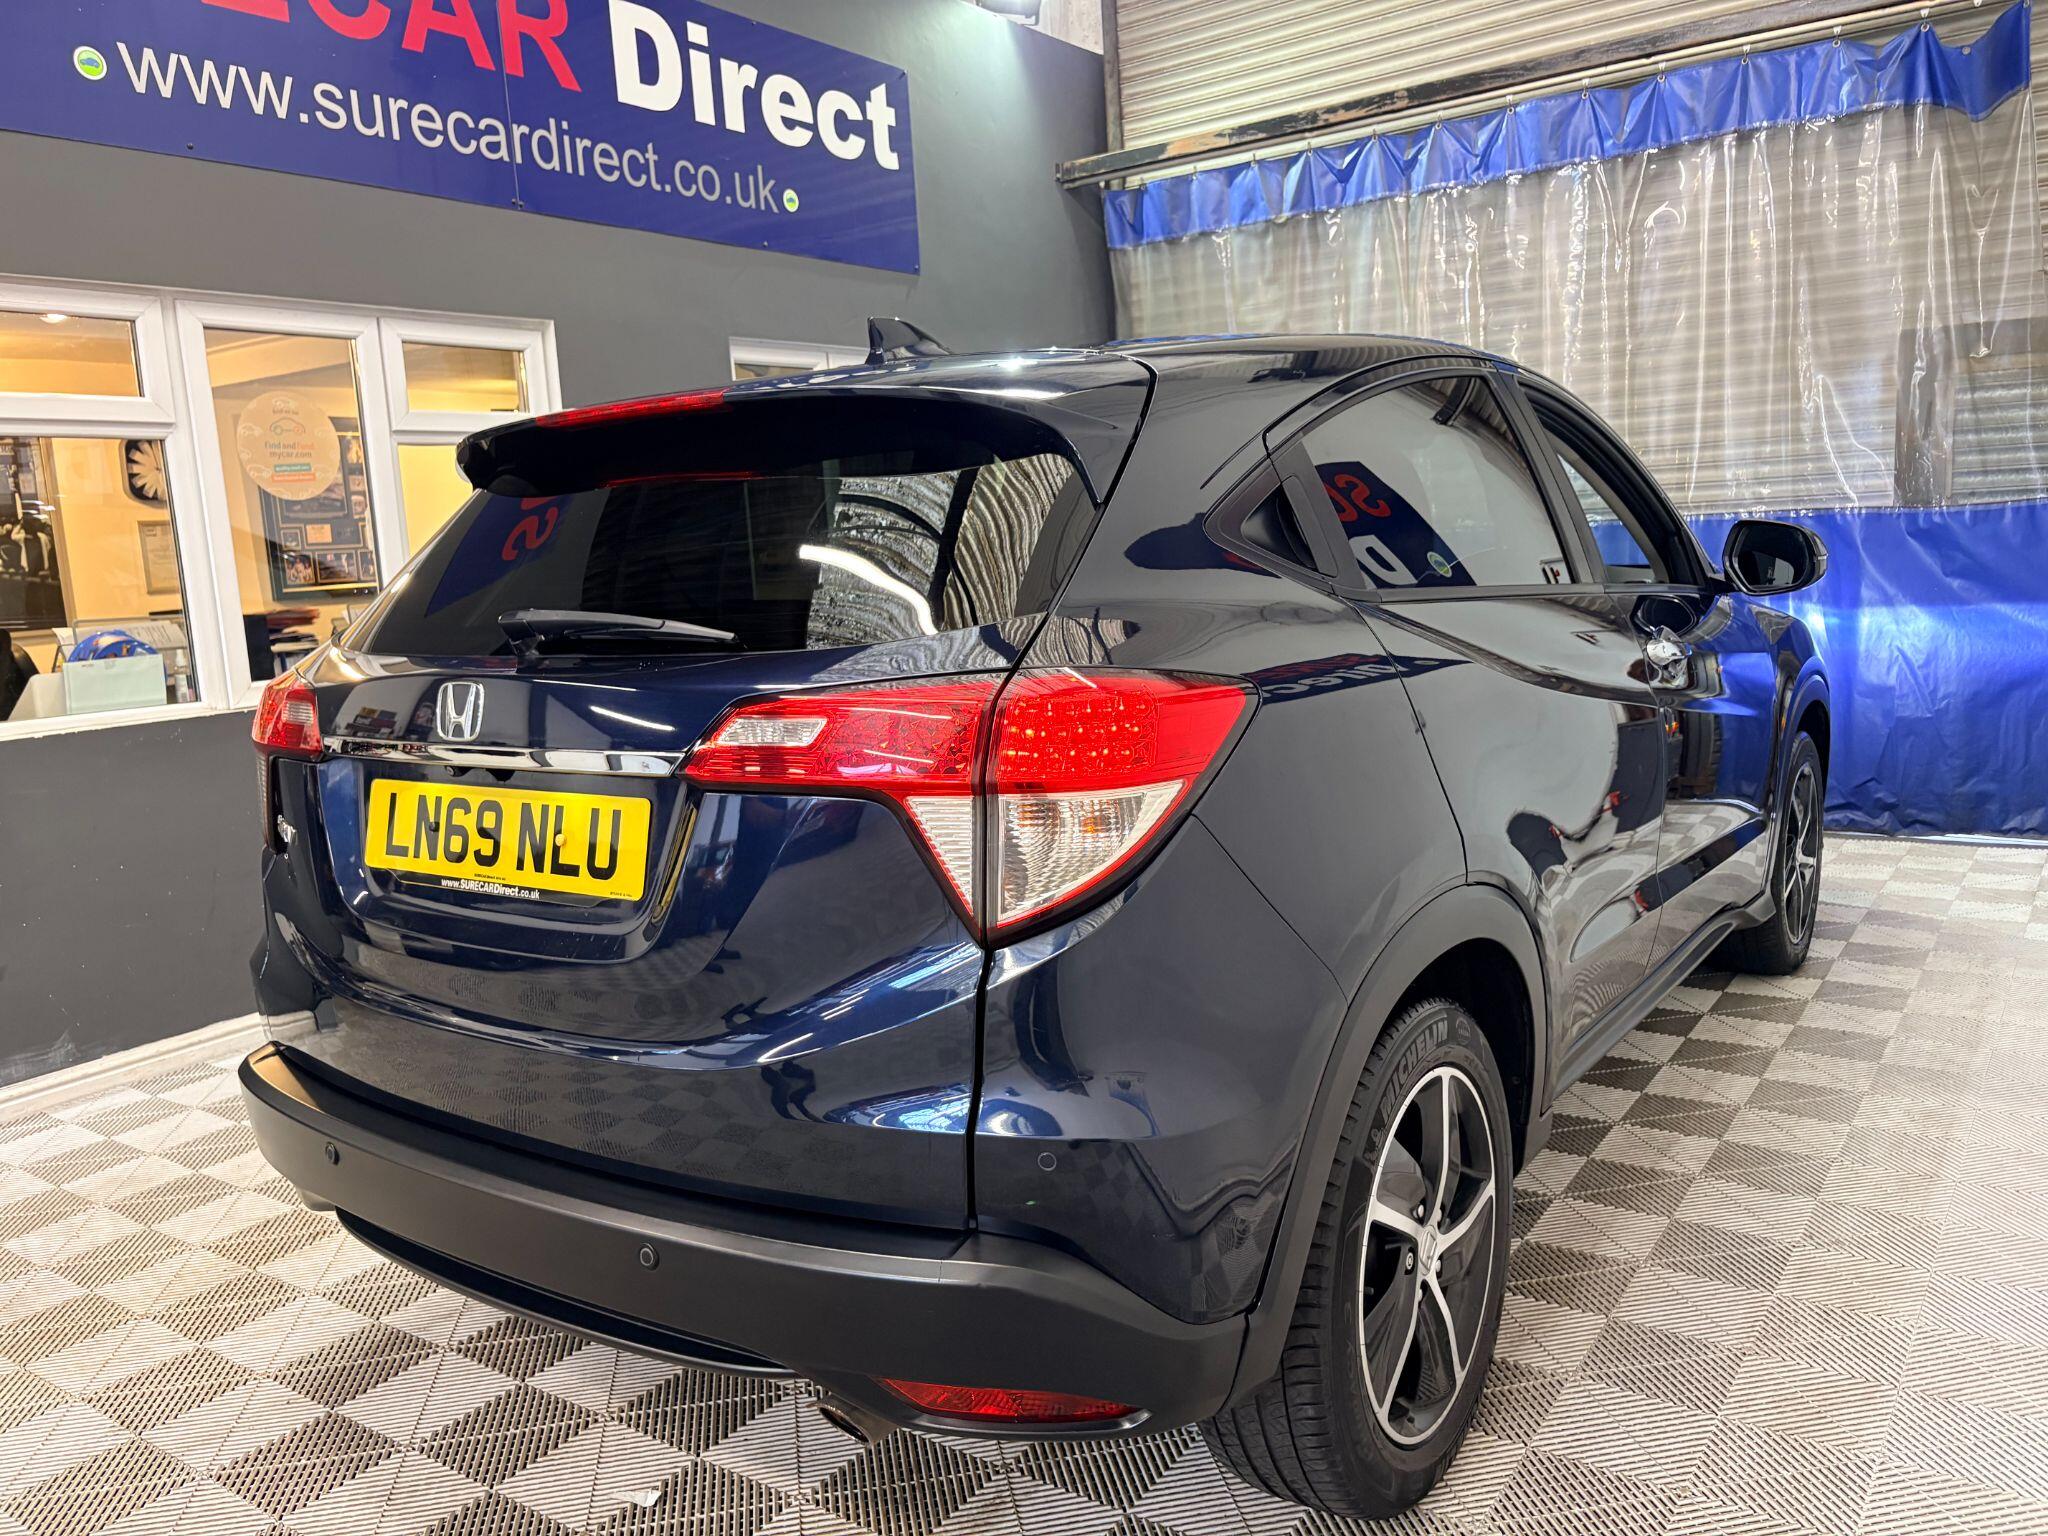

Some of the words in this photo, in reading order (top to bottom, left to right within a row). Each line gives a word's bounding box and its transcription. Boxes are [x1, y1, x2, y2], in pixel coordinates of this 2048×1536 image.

[116, 41, 780, 214] www.surecardirect.co.uk
[205, 0, 583, 93] AR
[608, 0, 900, 171] Direct
[385, 793, 503, 867] LN69
[516, 803, 622, 881] NLU
[441, 878, 540, 900] www.SURECARDirect.co.uk
[1379, 1018, 1449, 1126] MICHELIN
